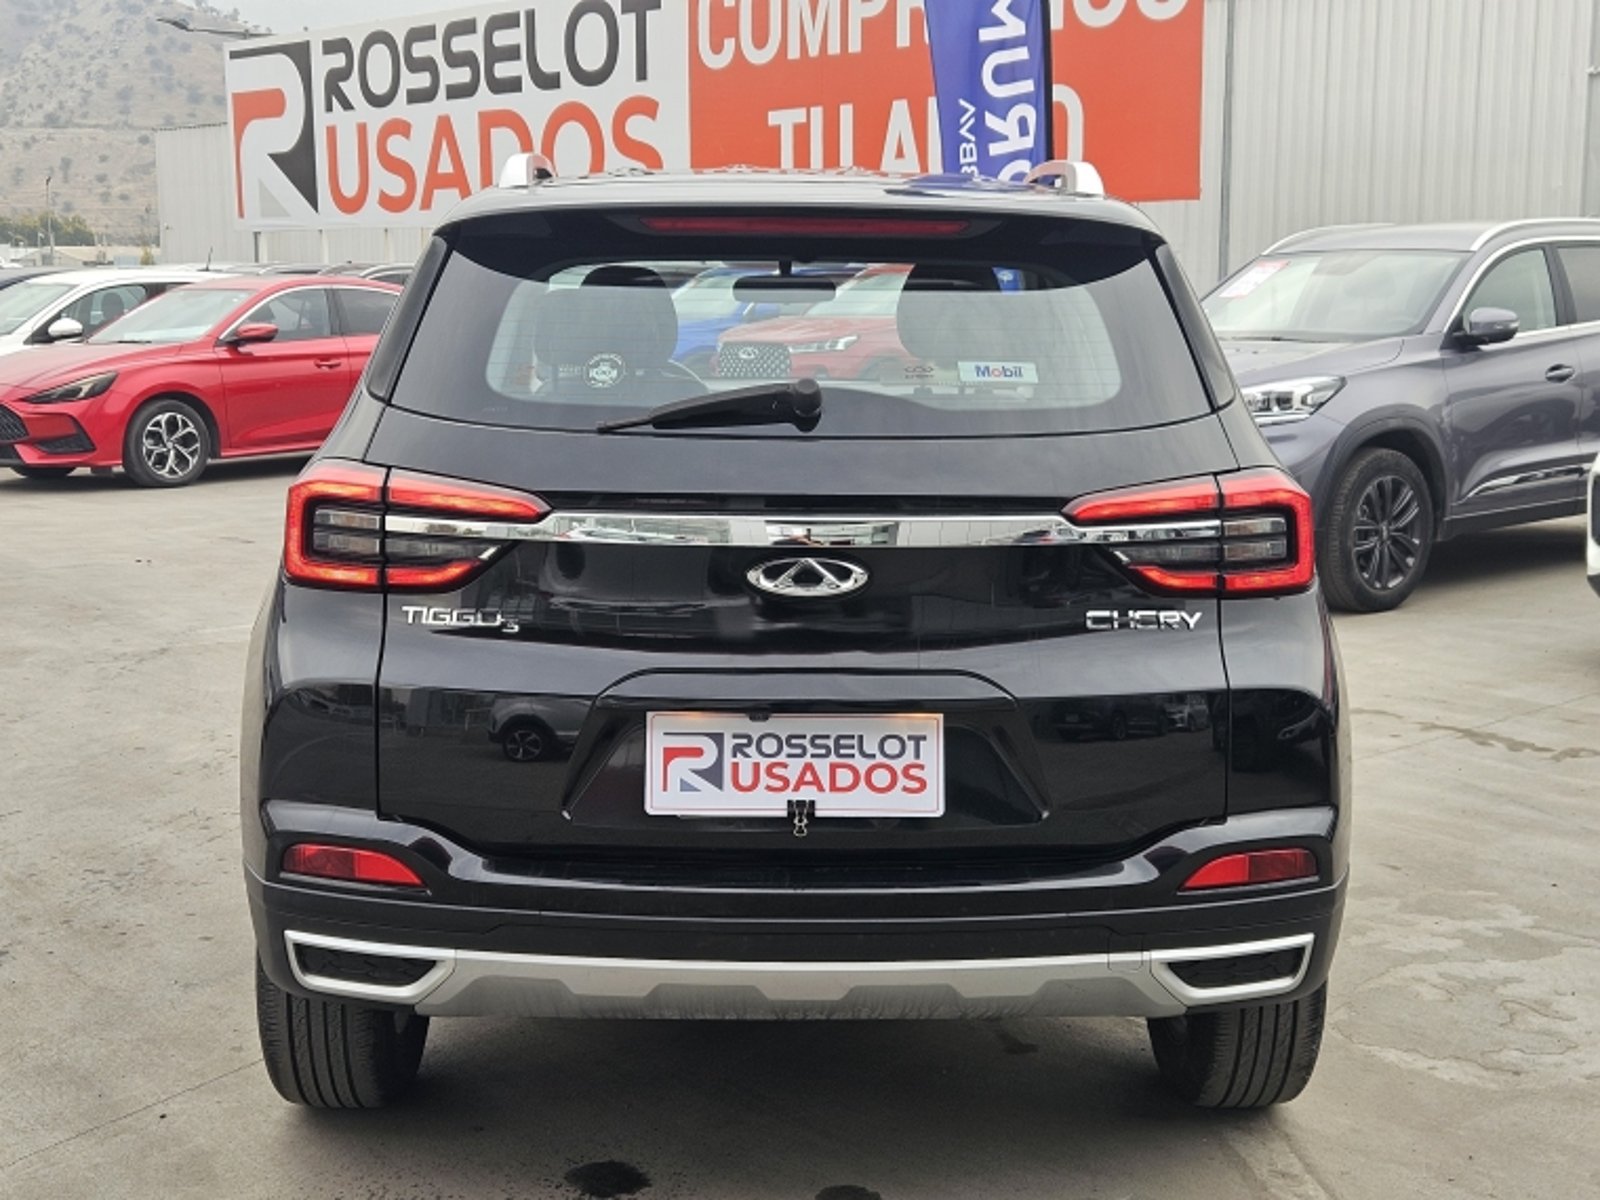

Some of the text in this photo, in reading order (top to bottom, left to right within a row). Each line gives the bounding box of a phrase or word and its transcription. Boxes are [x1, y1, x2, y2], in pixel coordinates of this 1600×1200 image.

[322, 0, 662, 113] ROSSELOT
[325, 95, 664, 215] USADOS
[975, 366, 1023, 378] Mobil
[1086, 609, 1203, 630] CHERY
[731, 732, 928, 759] ROSSELOT
[731, 762, 928, 795] USADOS
